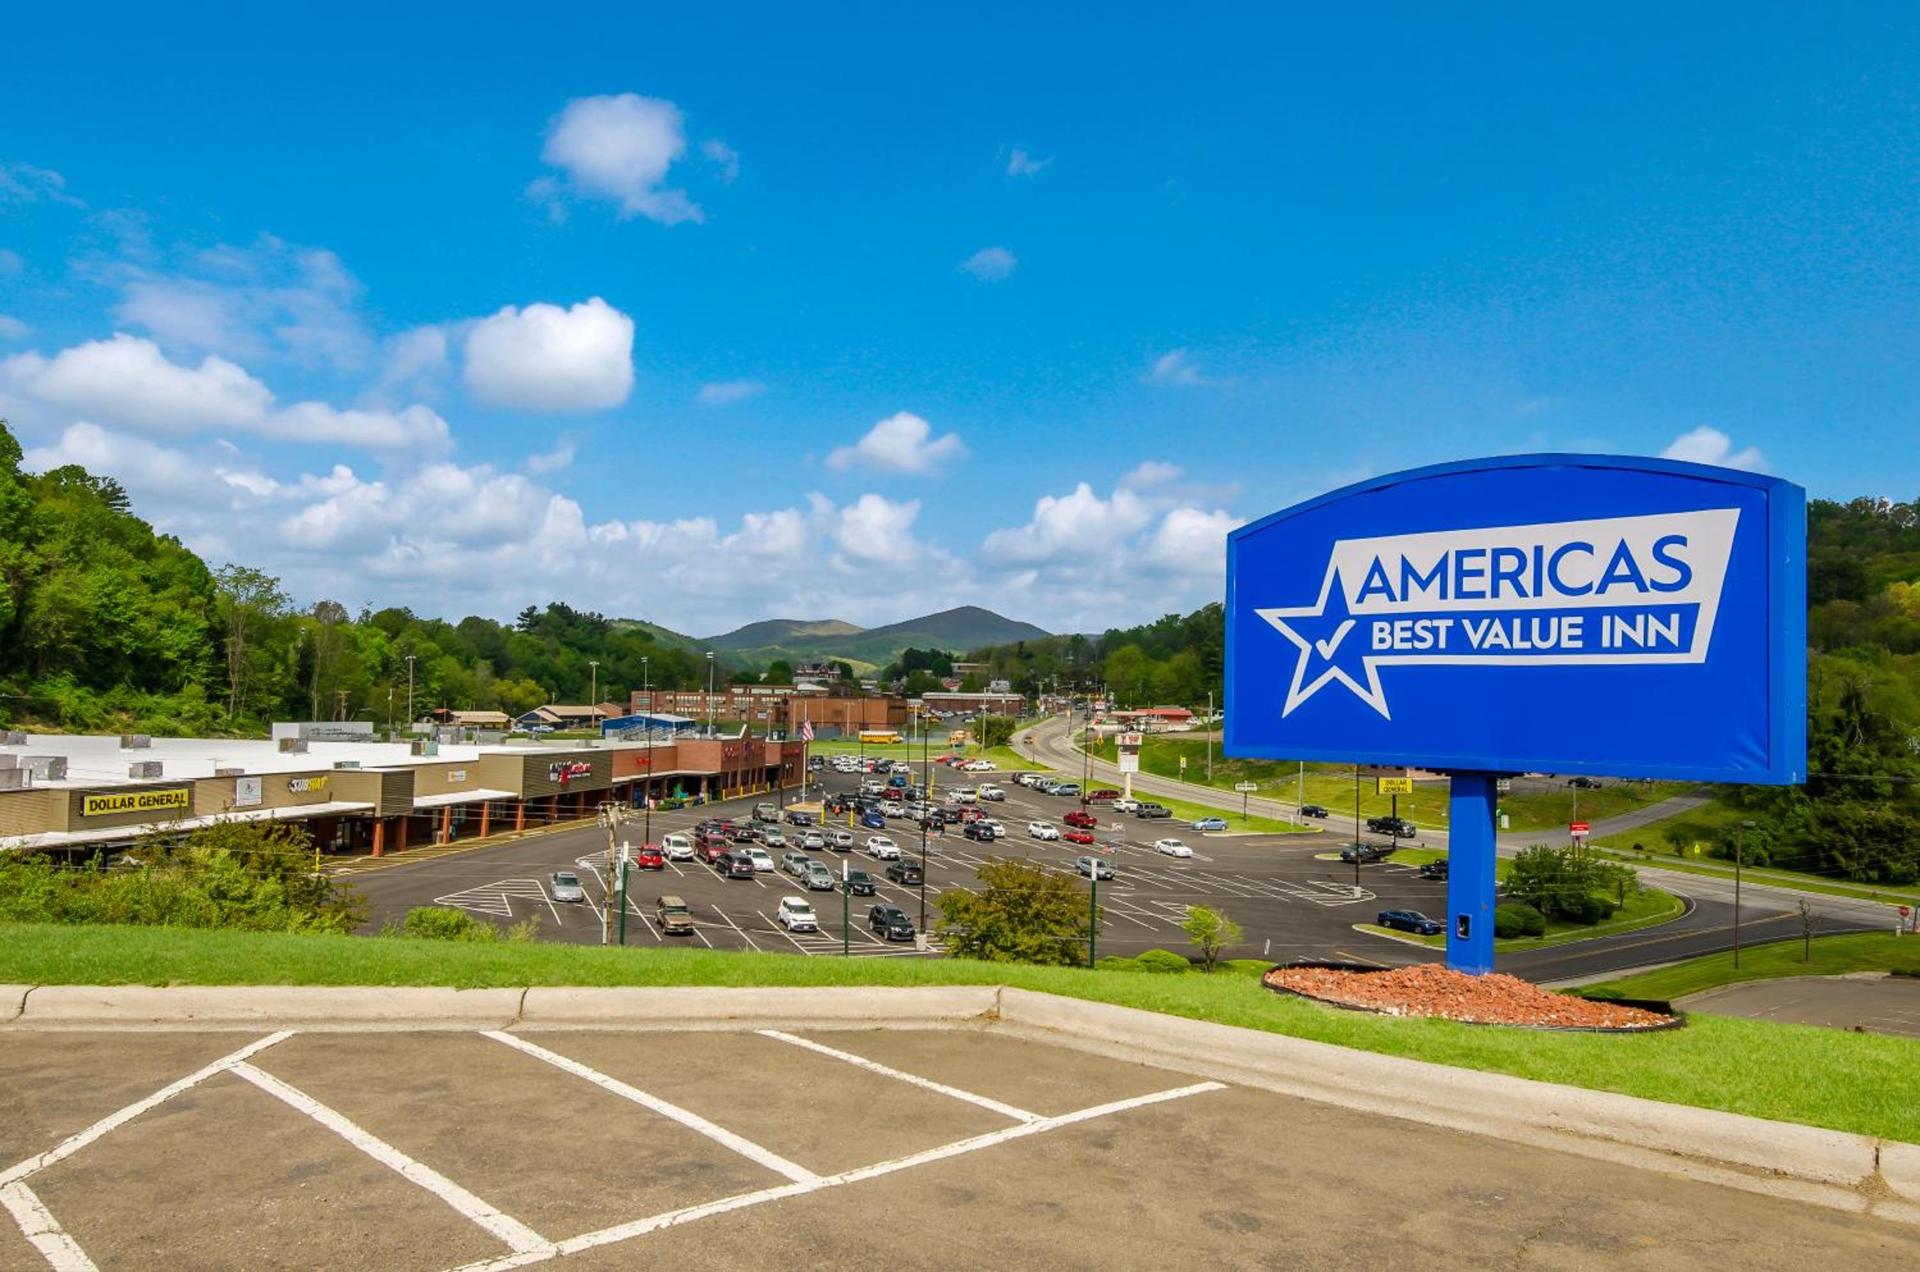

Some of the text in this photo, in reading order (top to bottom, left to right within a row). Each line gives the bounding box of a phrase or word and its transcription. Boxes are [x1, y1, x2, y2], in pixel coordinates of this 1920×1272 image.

[1355, 534, 1693, 604] AMERICAS
[1372, 613, 1680, 650] BEST VALUE INN
[88, 792, 186, 812] DOLLAR GENERAL
